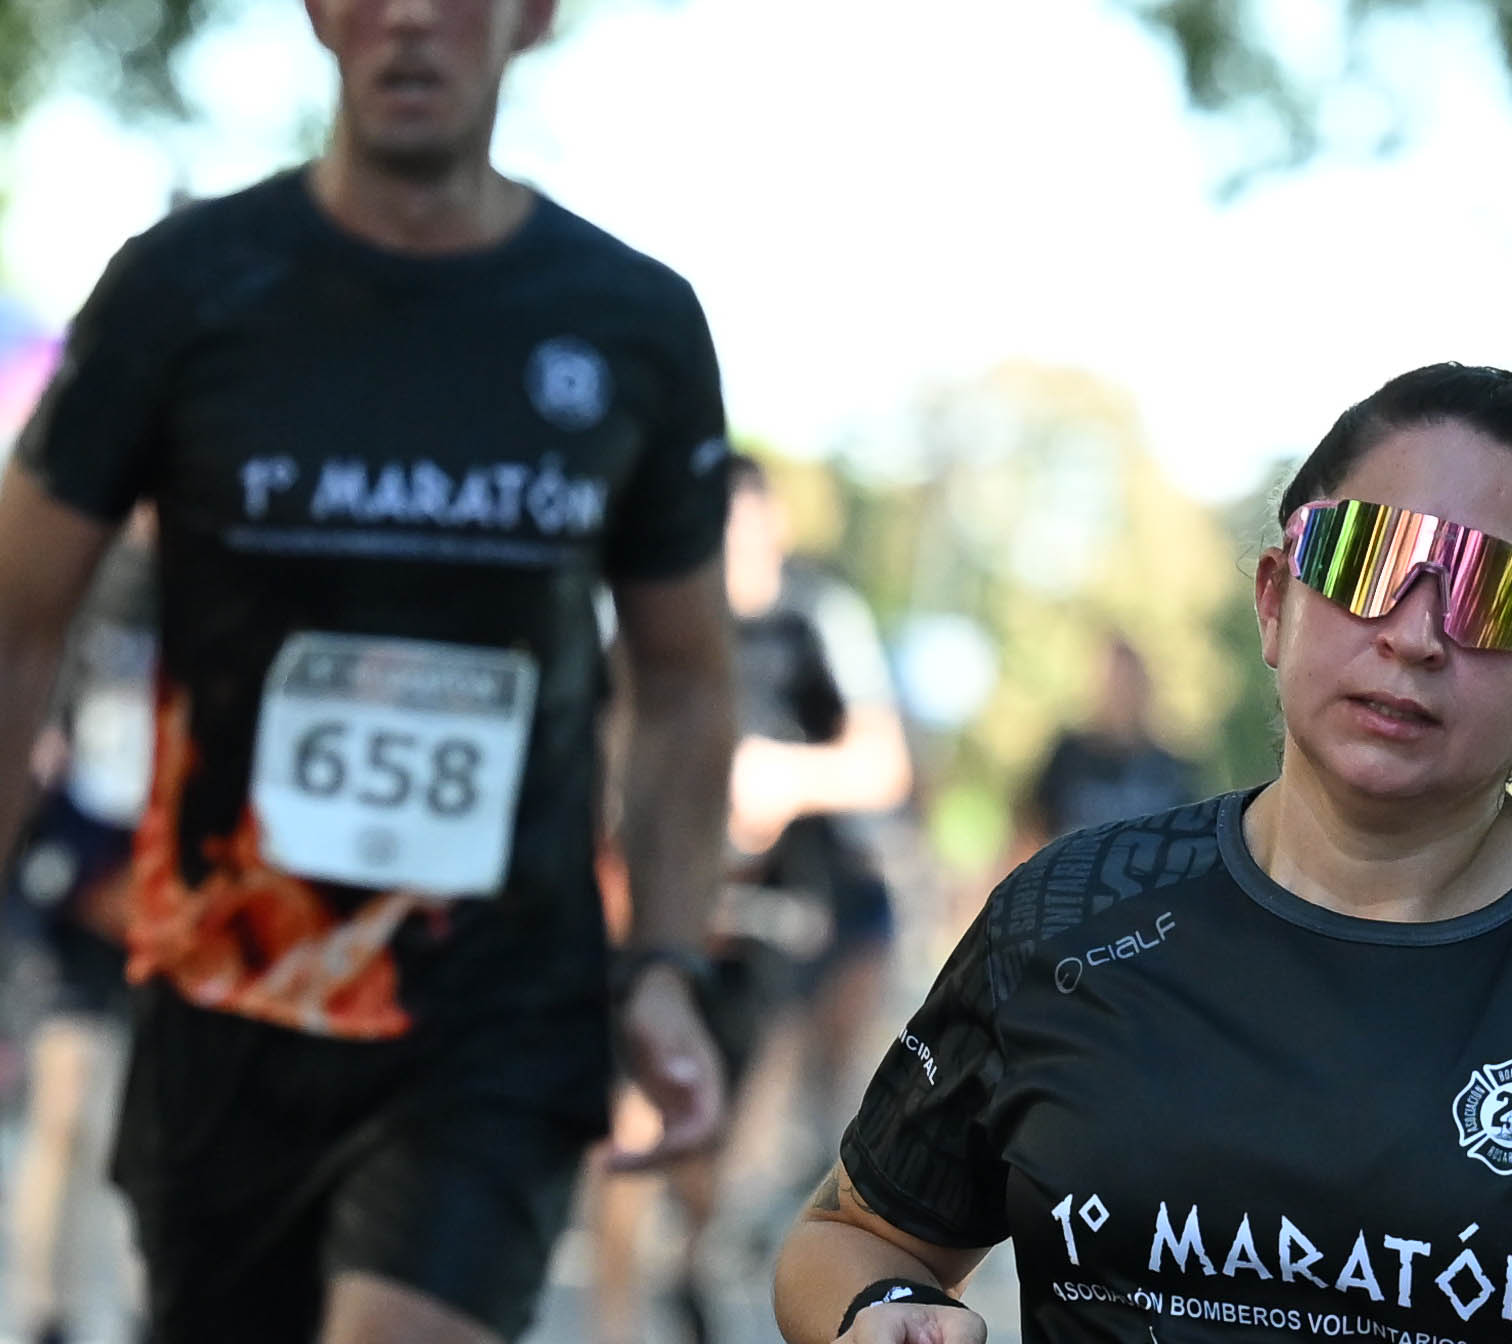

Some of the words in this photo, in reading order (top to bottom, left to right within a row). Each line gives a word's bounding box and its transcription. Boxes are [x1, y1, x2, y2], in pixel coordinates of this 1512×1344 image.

[294, 722, 483, 821] 658
[898, 1029, 938, 1087] ICIPAL
[1170, 1294, 1302, 1331] BOMBEROS
